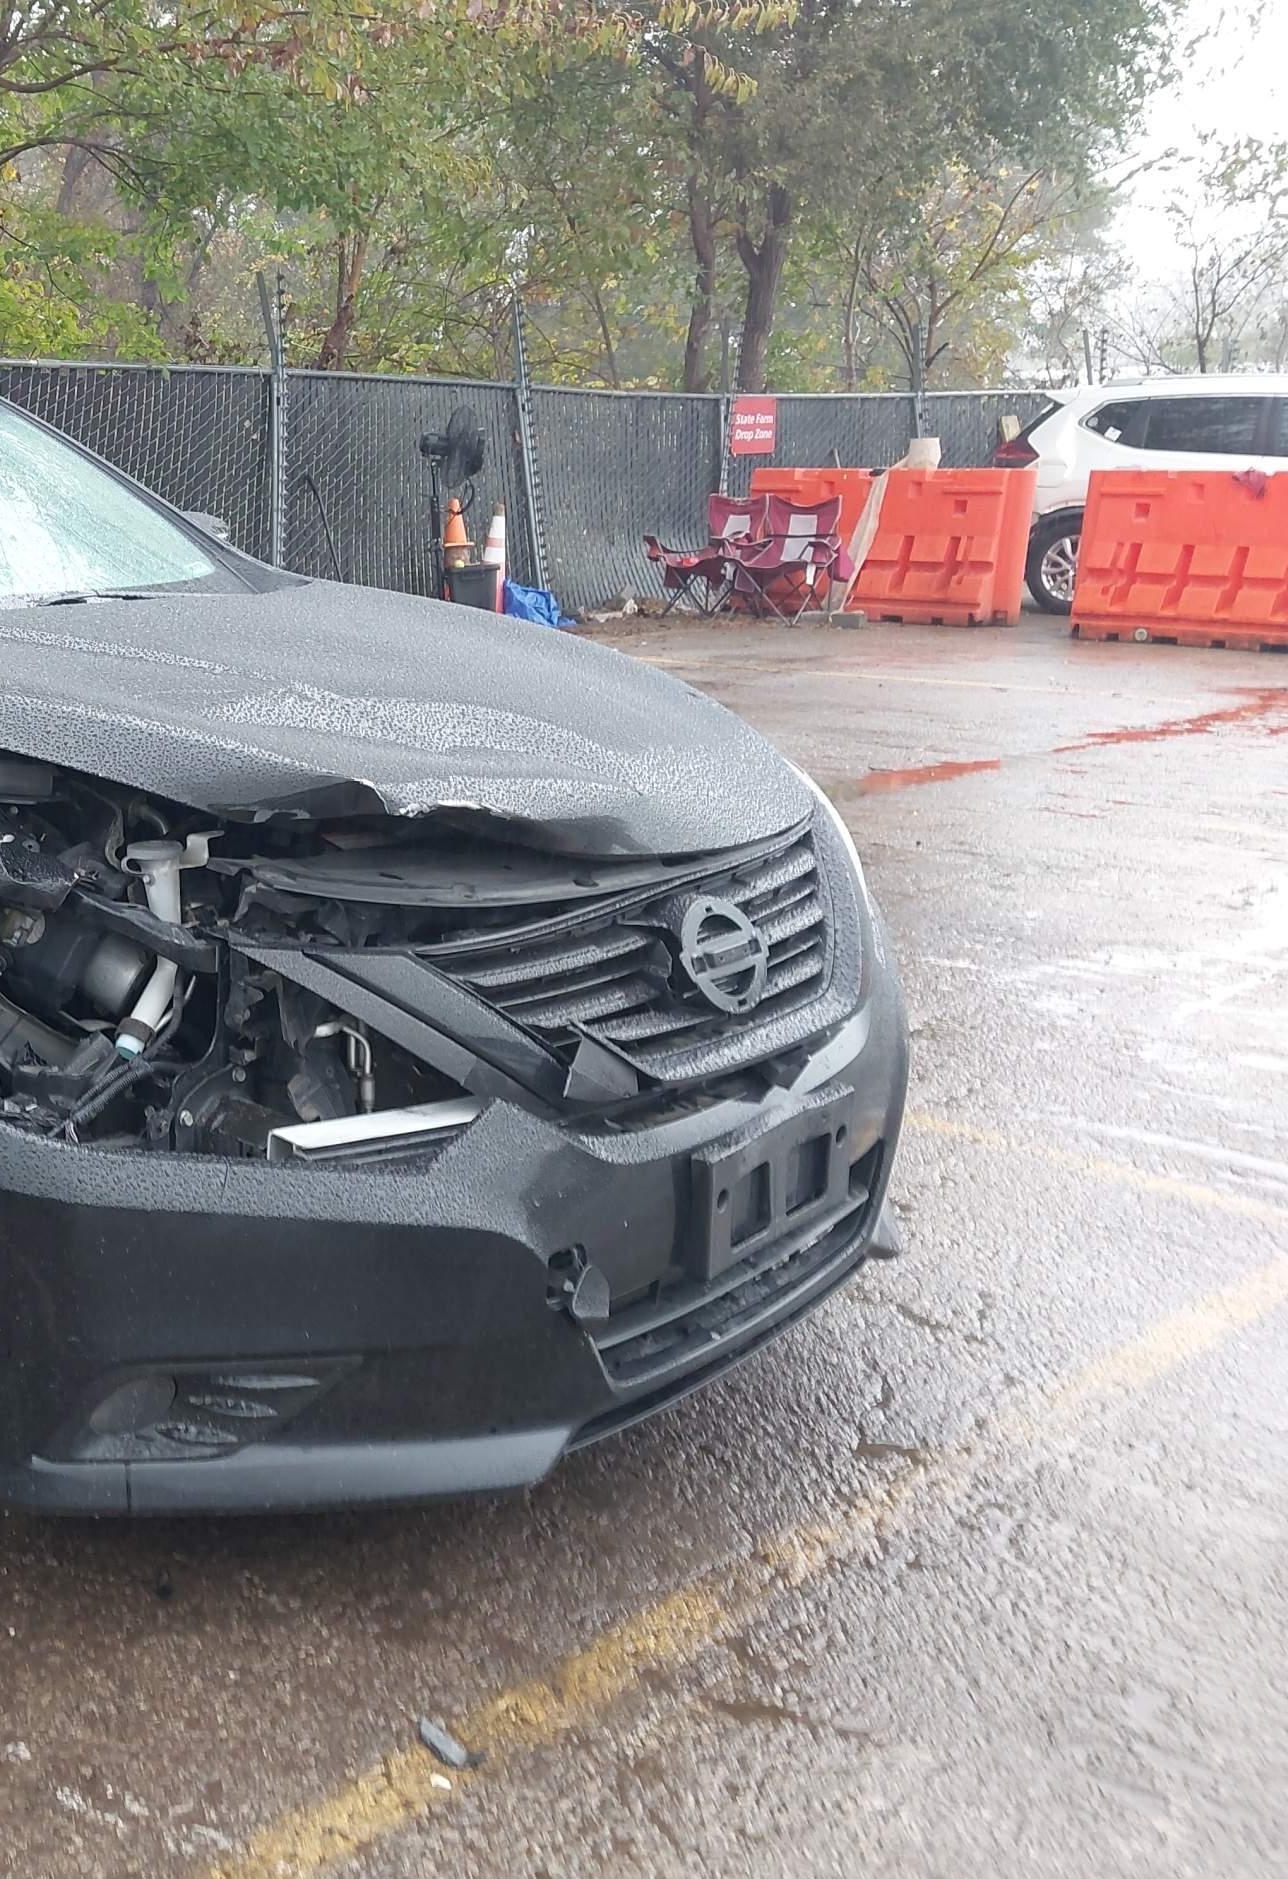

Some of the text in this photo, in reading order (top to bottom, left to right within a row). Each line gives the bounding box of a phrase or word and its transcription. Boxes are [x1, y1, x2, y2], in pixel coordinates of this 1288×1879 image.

[735, 413, 774, 424] State Farm
[735, 428, 772, 441] Drop Zone
